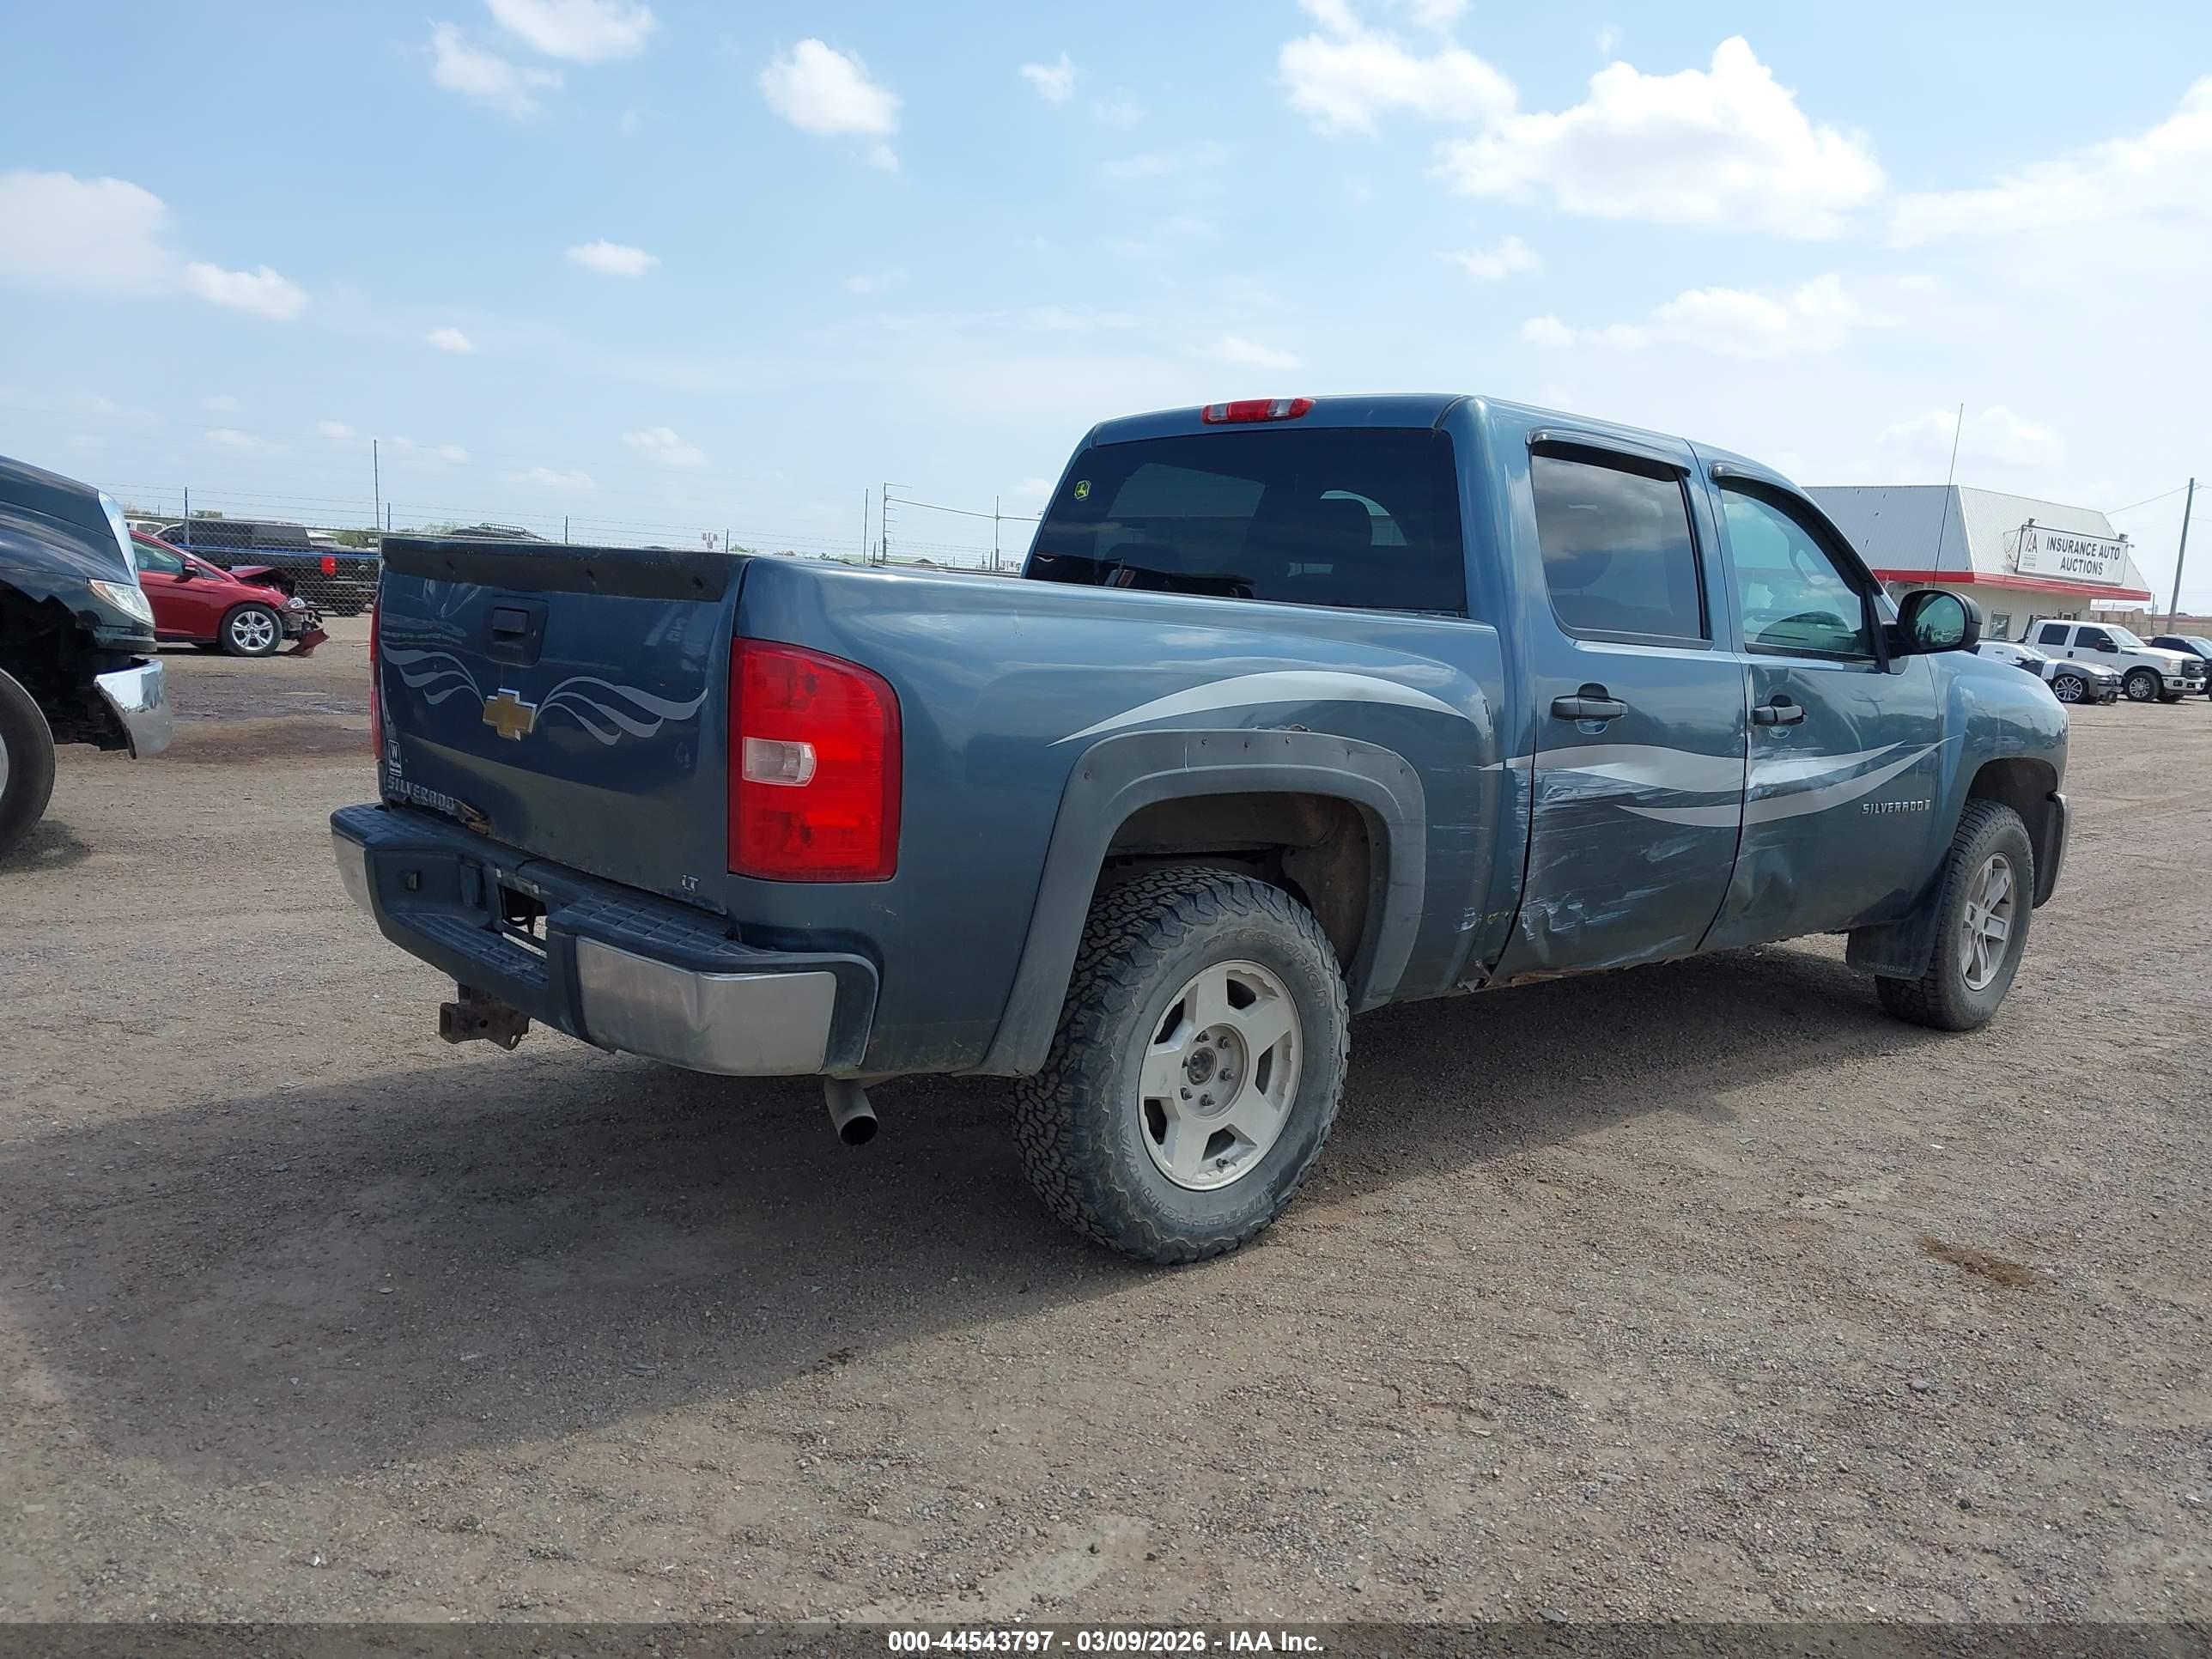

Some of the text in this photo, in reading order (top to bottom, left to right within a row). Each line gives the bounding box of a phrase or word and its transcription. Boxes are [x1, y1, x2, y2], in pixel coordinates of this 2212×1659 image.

[2046, 535, 2120, 561] INSURANCE AUTO
[2060, 556, 2103, 575] AUCTIONS
[386, 775, 455, 811] SILVERADO
[1862, 799, 1924, 815] SILVERADO
[681, 874, 699, 892] LT
